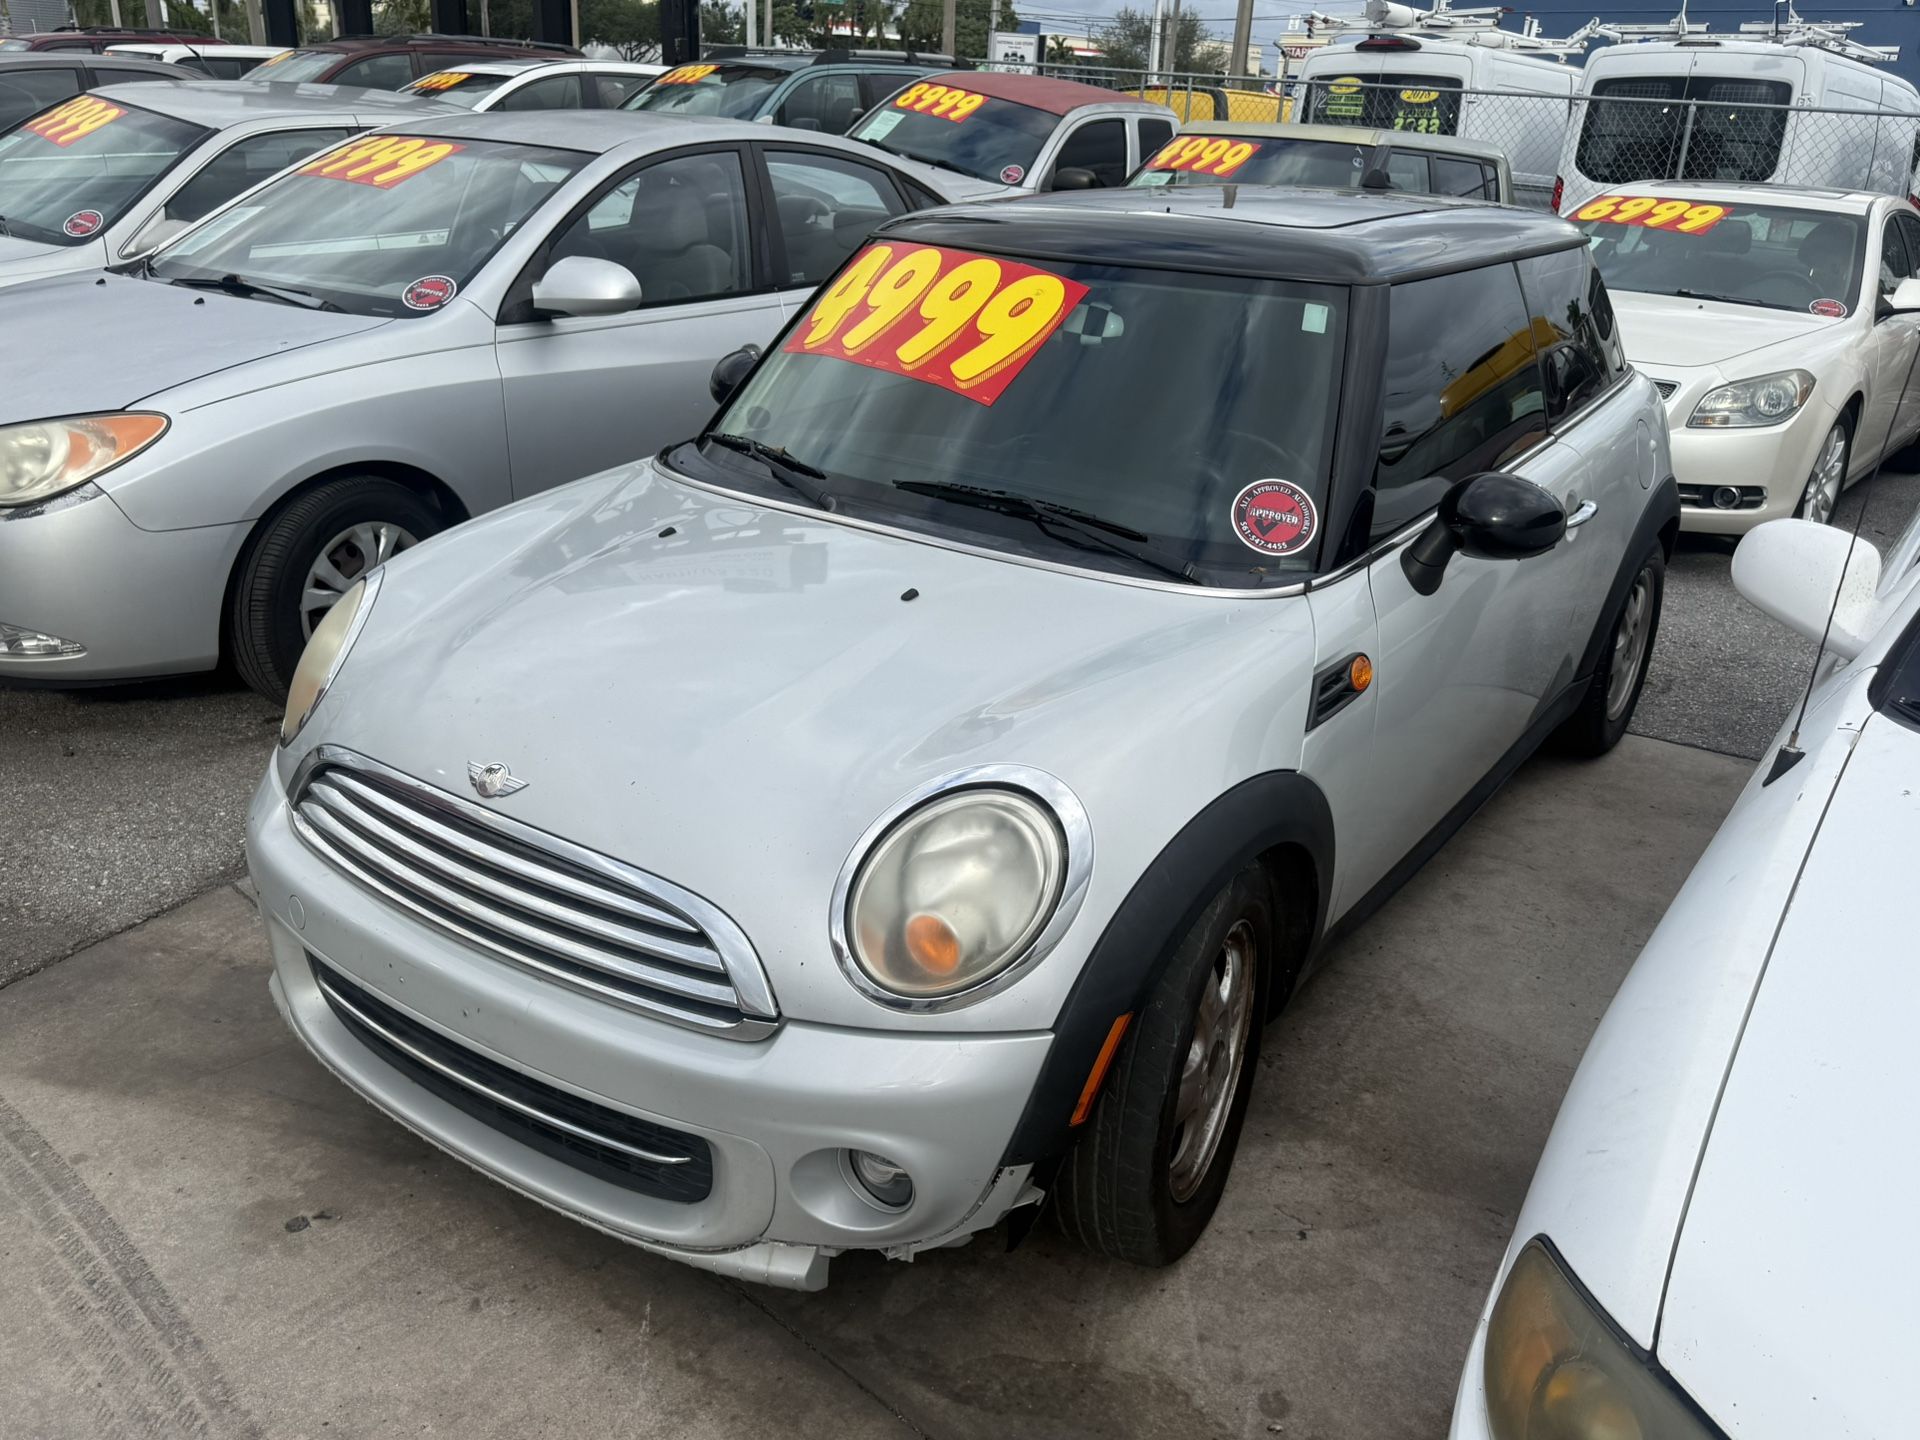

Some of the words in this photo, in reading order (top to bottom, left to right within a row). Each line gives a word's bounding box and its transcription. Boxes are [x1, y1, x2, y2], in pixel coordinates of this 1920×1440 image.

[896, 83, 984, 121] 8999
[1153, 136, 1253, 175] 4999
[1577, 196, 1724, 232] 6999
[803, 245, 1066, 390] 4999
[1240, 497, 1252, 509] ALL
[1253, 485, 1292, 496] APPROVED
[1293, 495, 1310, 535] AUTOWORKS
[1239, 521, 1288, 550] 561-547-4455
